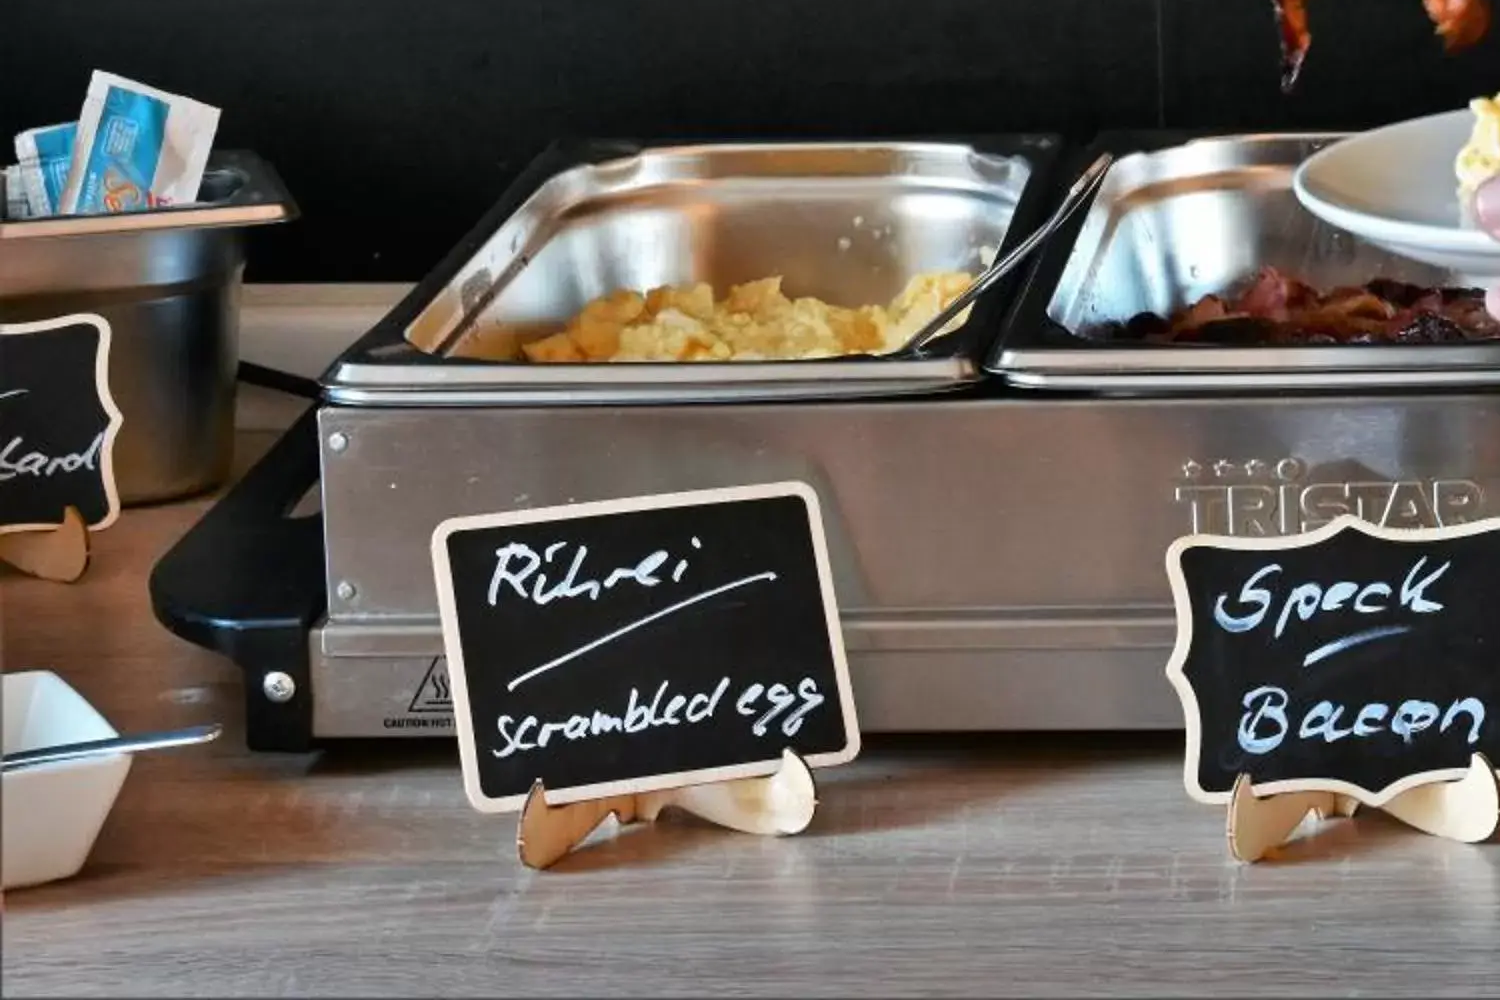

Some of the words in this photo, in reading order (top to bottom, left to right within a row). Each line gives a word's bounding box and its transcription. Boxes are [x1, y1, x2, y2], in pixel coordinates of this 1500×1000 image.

[1213, 556, 1451, 639] Speck
[491, 677, 731, 758] scrambled
[736, 677, 825, 737] egg
[1237, 685, 1486, 754] Bacon
